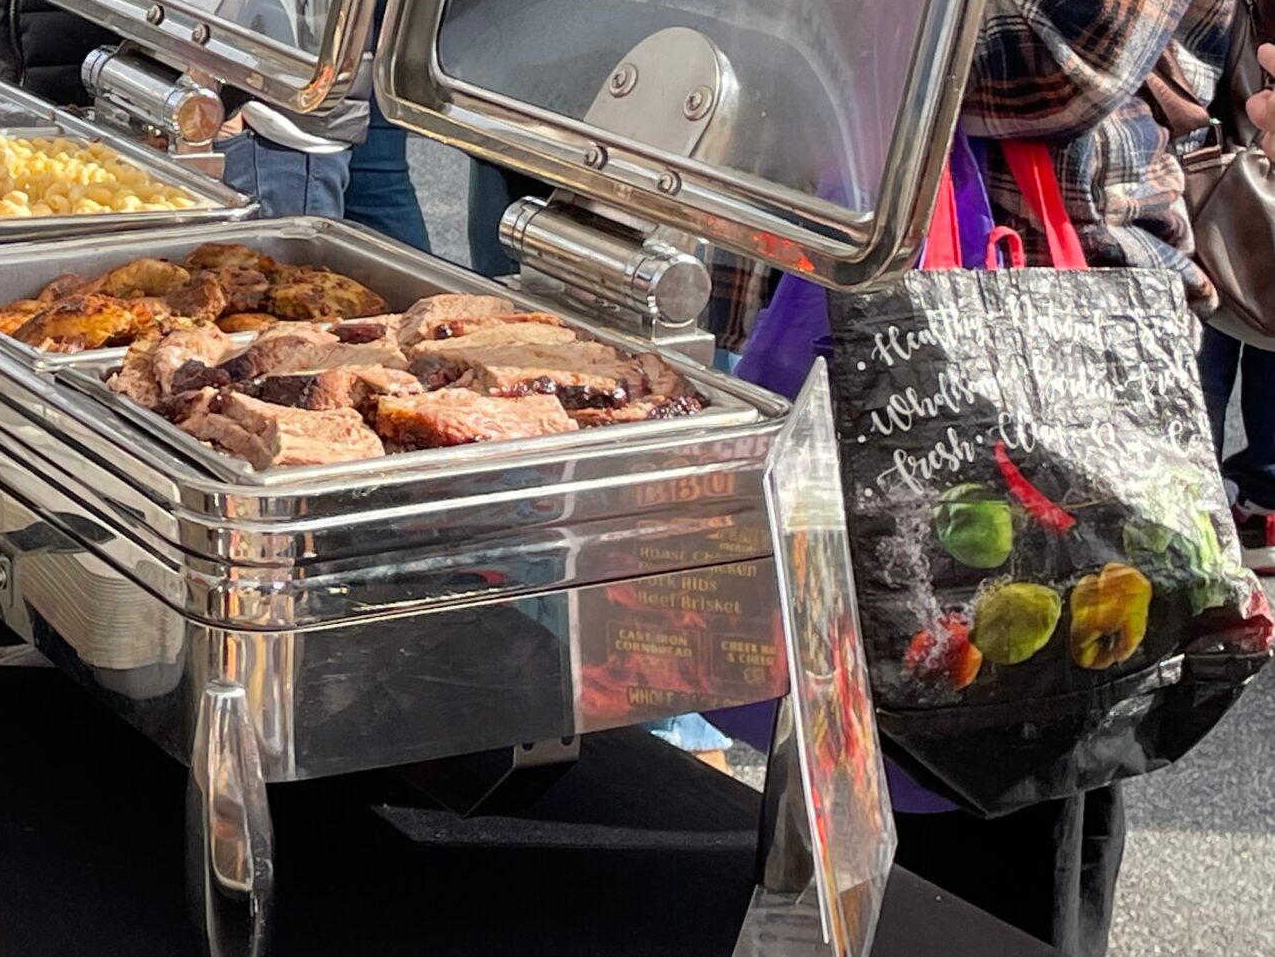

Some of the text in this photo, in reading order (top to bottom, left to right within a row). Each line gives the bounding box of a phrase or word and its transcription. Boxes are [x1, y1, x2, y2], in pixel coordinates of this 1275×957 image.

[871, 300, 992, 366] Healthy
[877, 427, 975, 494] fresh
[681, 595, 742, 614] Brisket
[618, 629, 651, 642] CAST
